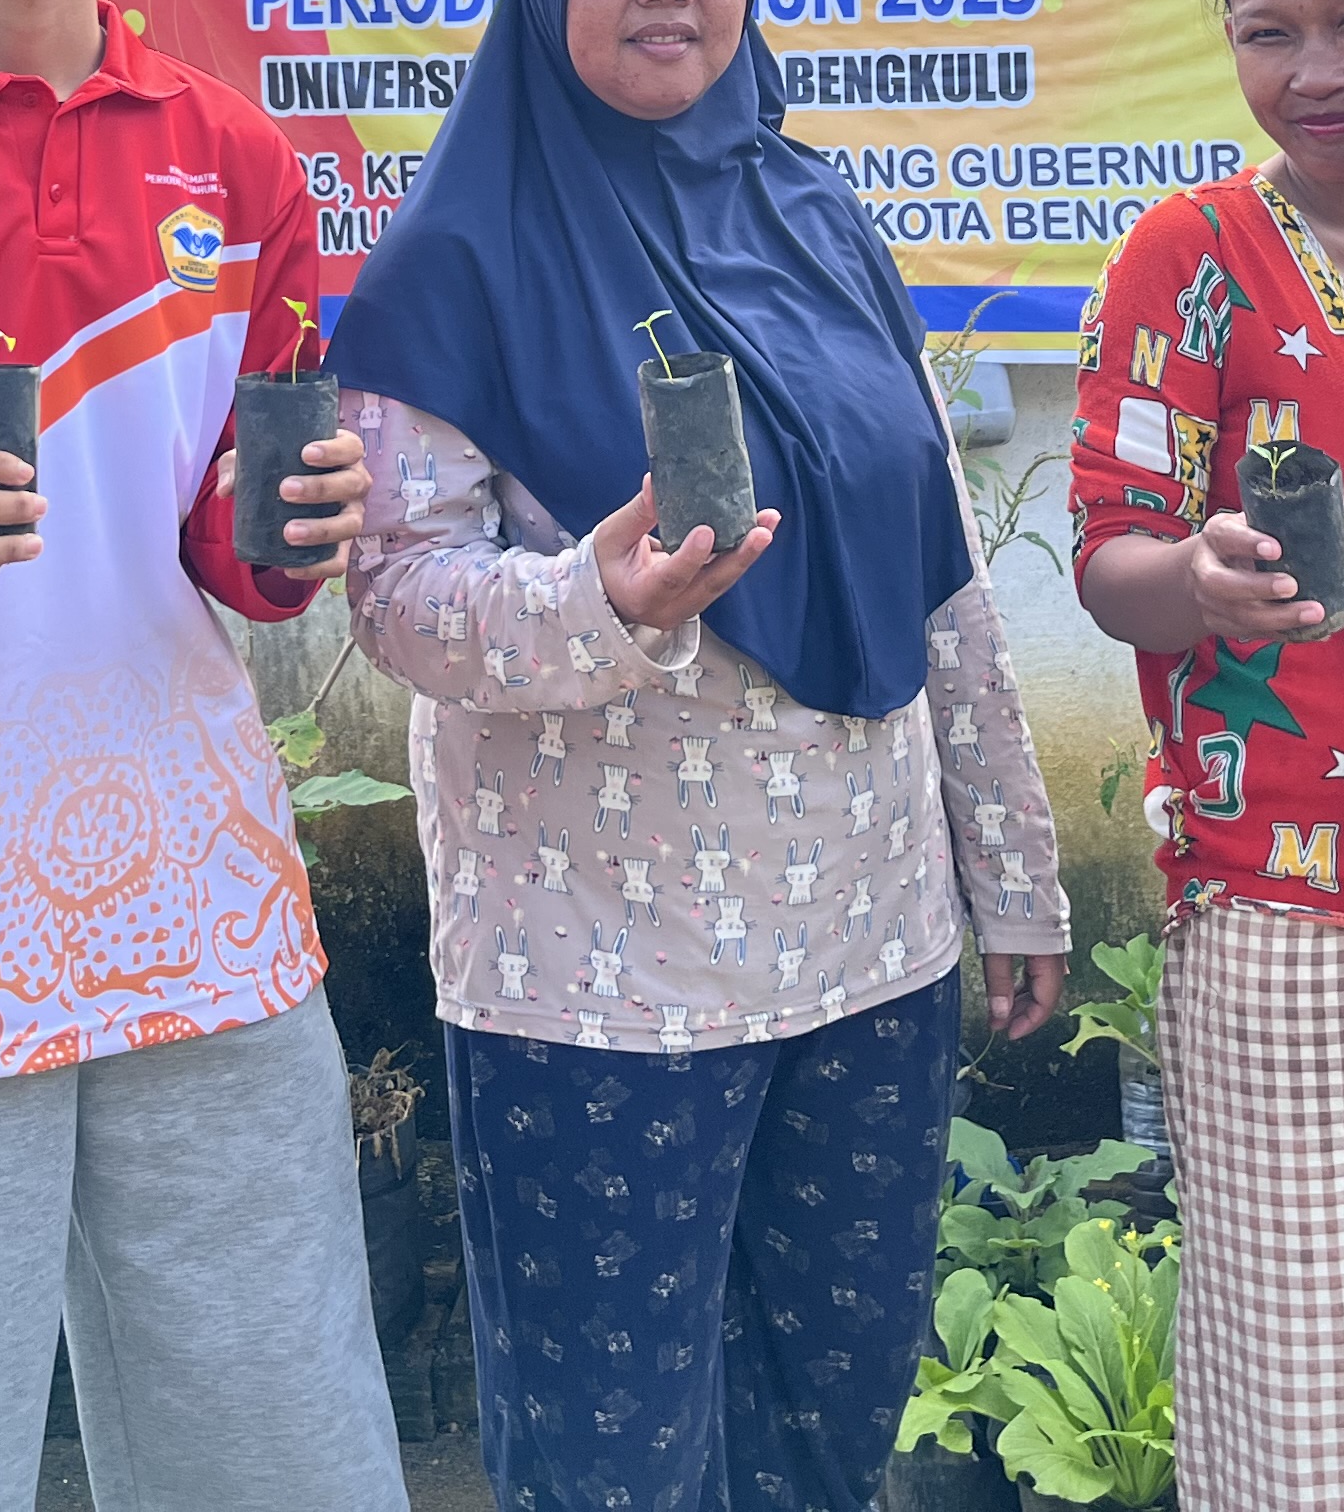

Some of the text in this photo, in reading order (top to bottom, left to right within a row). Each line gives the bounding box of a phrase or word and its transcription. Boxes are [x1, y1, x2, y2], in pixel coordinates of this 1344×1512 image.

[267, 52, 1028, 110] UNIVERS BENGKULU
[298, 156, 350, 204] 5,
[818, 148, 936, 189] ANG
[952, 144, 1241, 187] GUBERNUR
